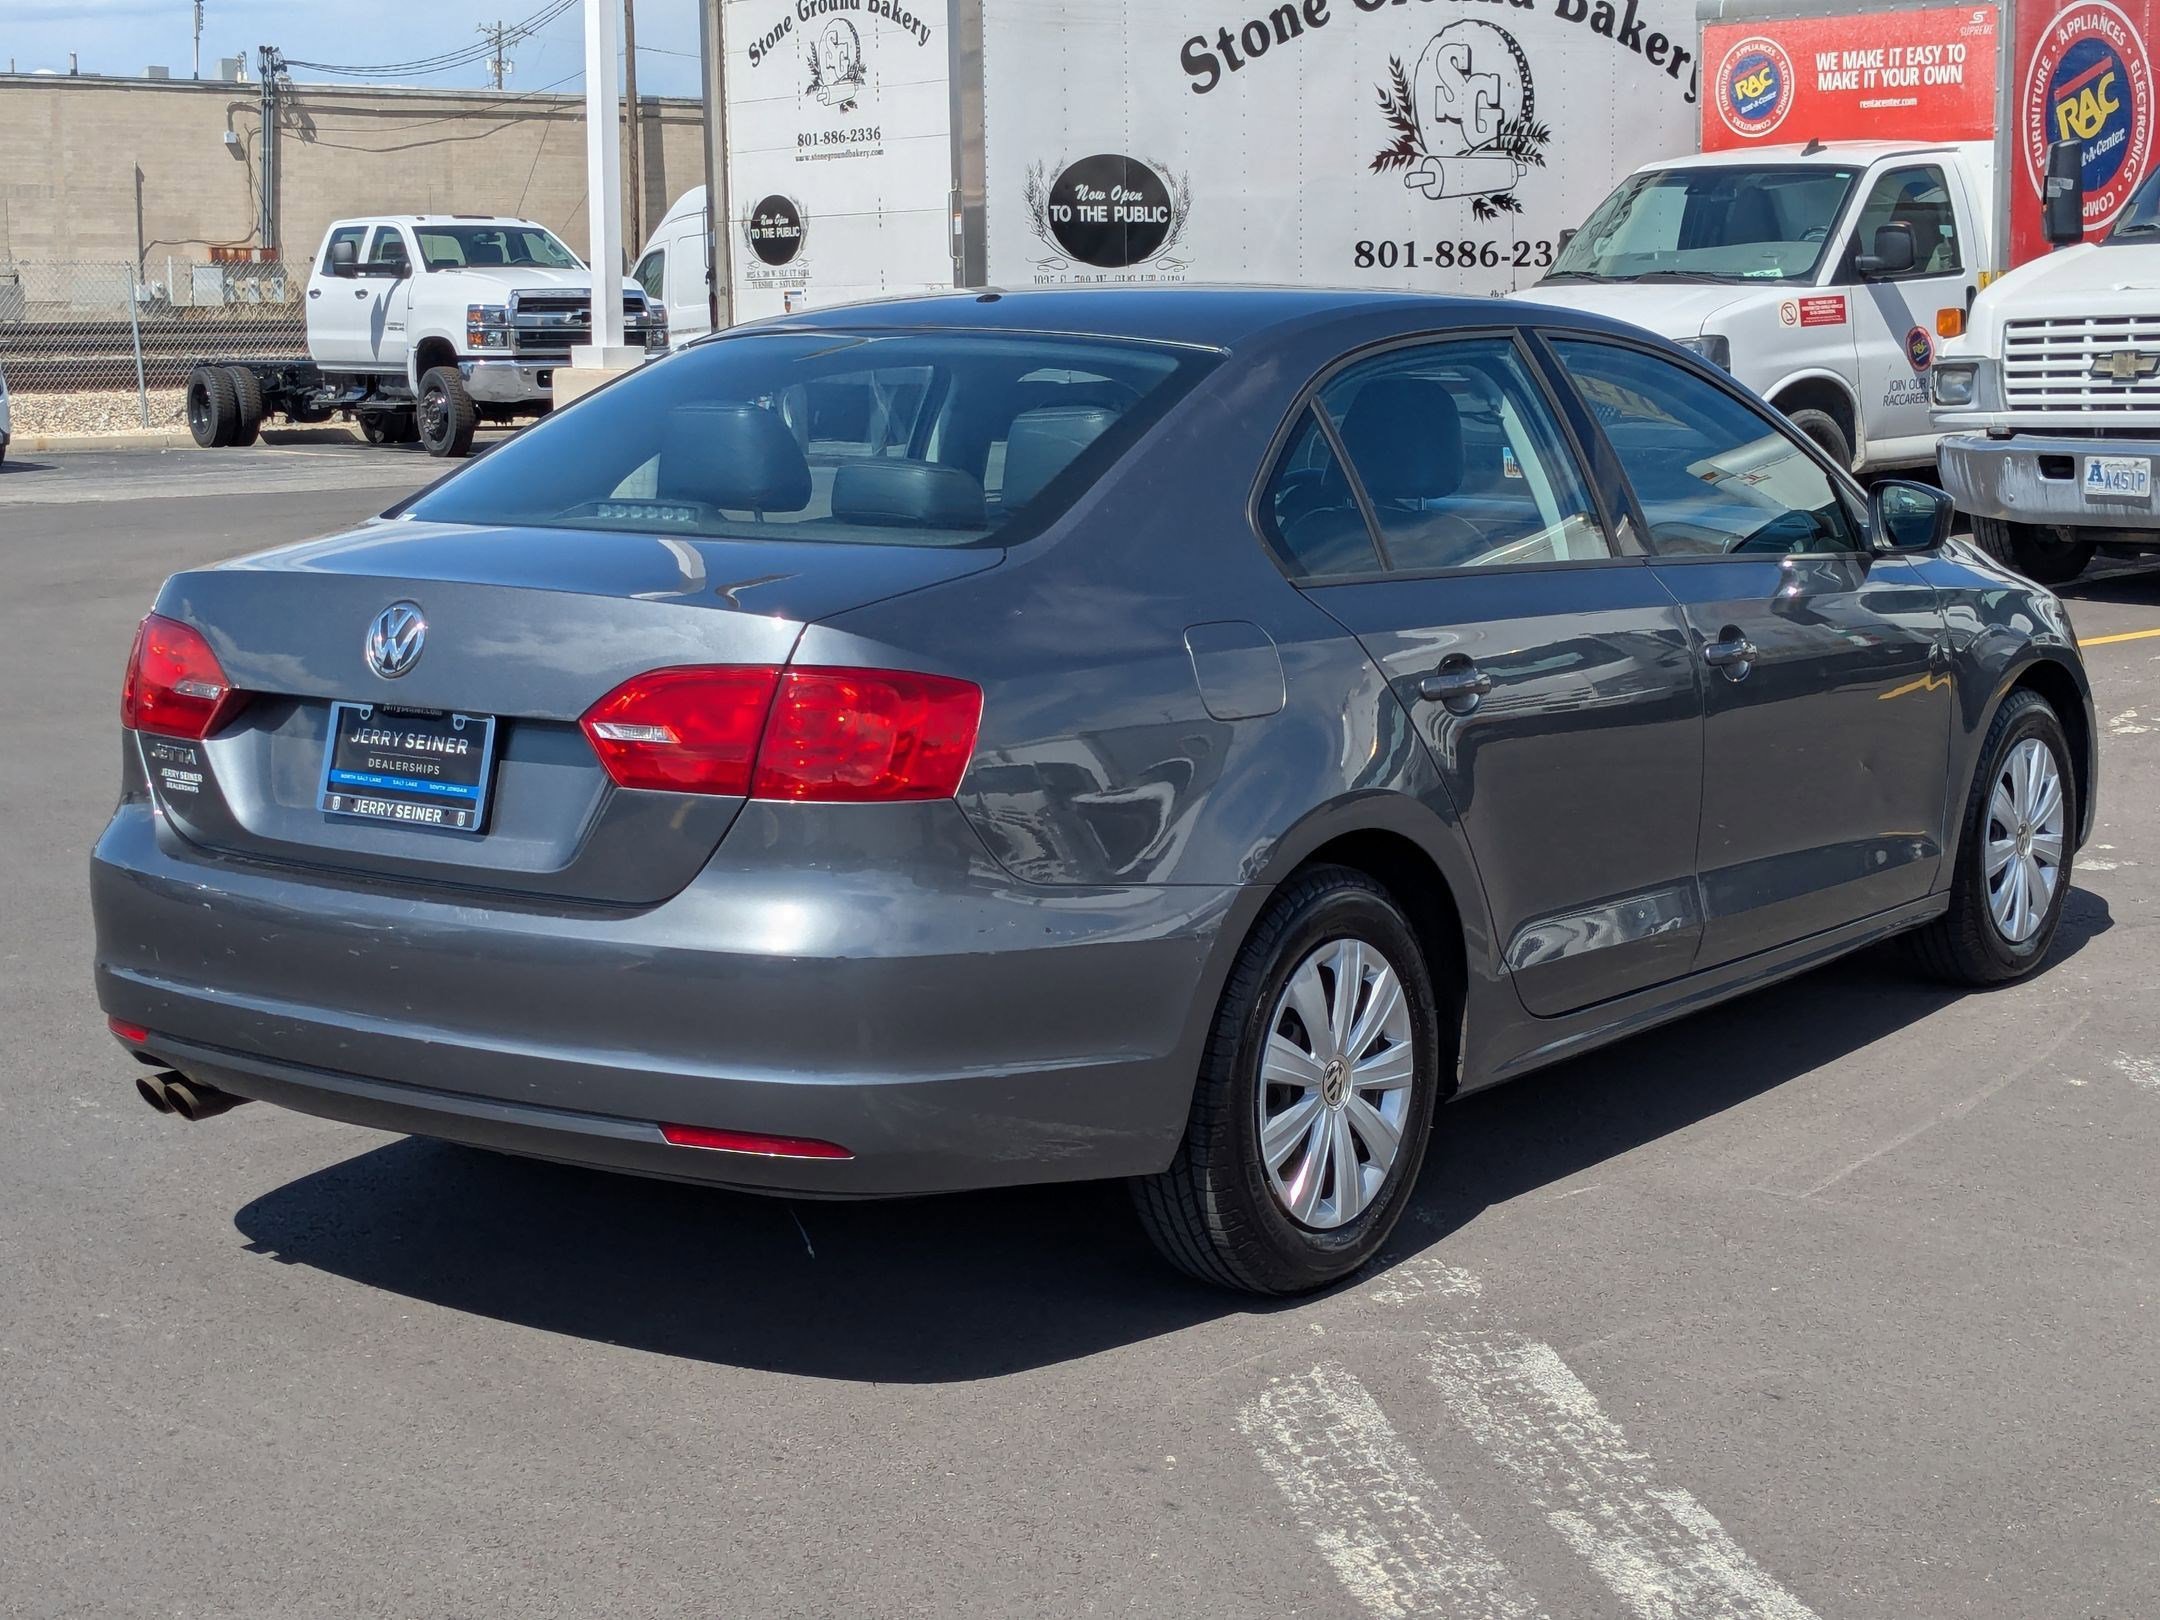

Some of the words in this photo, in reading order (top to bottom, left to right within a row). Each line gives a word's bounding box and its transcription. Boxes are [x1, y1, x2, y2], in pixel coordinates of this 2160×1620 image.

[748, 15, 793, 68] Stone
[2059, 13, 2127, 46] APPLIANCES
[1180, 0, 1331, 95] Stone
[1736, 43, 1777, 59] APPLIANCES
[1816, 52, 1839, 72] WE
[1842, 48, 1884, 70] MAKE
[1889, 47, 1903, 67] IT
[1906, 44, 1943, 66] EASY
[1946, 43, 1966, 64] TO
[1720, 63, 1733, 112] FURNITURE
[1734, 66, 1774, 101] RAC
[1817, 70, 1859, 91] MAKE
[1863, 69, 1878, 89] IT
[1881, 67, 1919, 88] YOUR
[1924, 64, 1963, 85] OWN
[2031, 55, 2052, 169] FURNITURE
[2056, 71, 2120, 141] RAC
[2123, 58, 2147, 183] ELECTRONICS
[797, 126, 882, 148] 801-886-2336
[1074, 183, 1106, 202] Now
[1110, 184, 1144, 205] Open
[1050, 205, 1072, 223] TO
[1077, 205, 1109, 223] THE
[1113, 205, 1168, 224] PUBLIC
[751, 228, 760, 240] TO
[761, 228, 775, 239] THE
[776, 226, 801, 239] PUBLIC
[1353, 240, 1553, 269] 801-886-23
[1887, 379, 1907, 395] JOIN
[1909, 377, 1927, 391] OUR
[351, 727, 404, 747] JERRY
[405, 732, 469, 755] SEINER
[160, 767, 180, 779] JERRY
[180, 770, 203, 783] SEINER
[368, 757, 440, 776] DEALERSHIPS
[353, 799, 395, 817] JERRY
[395, 804, 442, 823] SEINER
